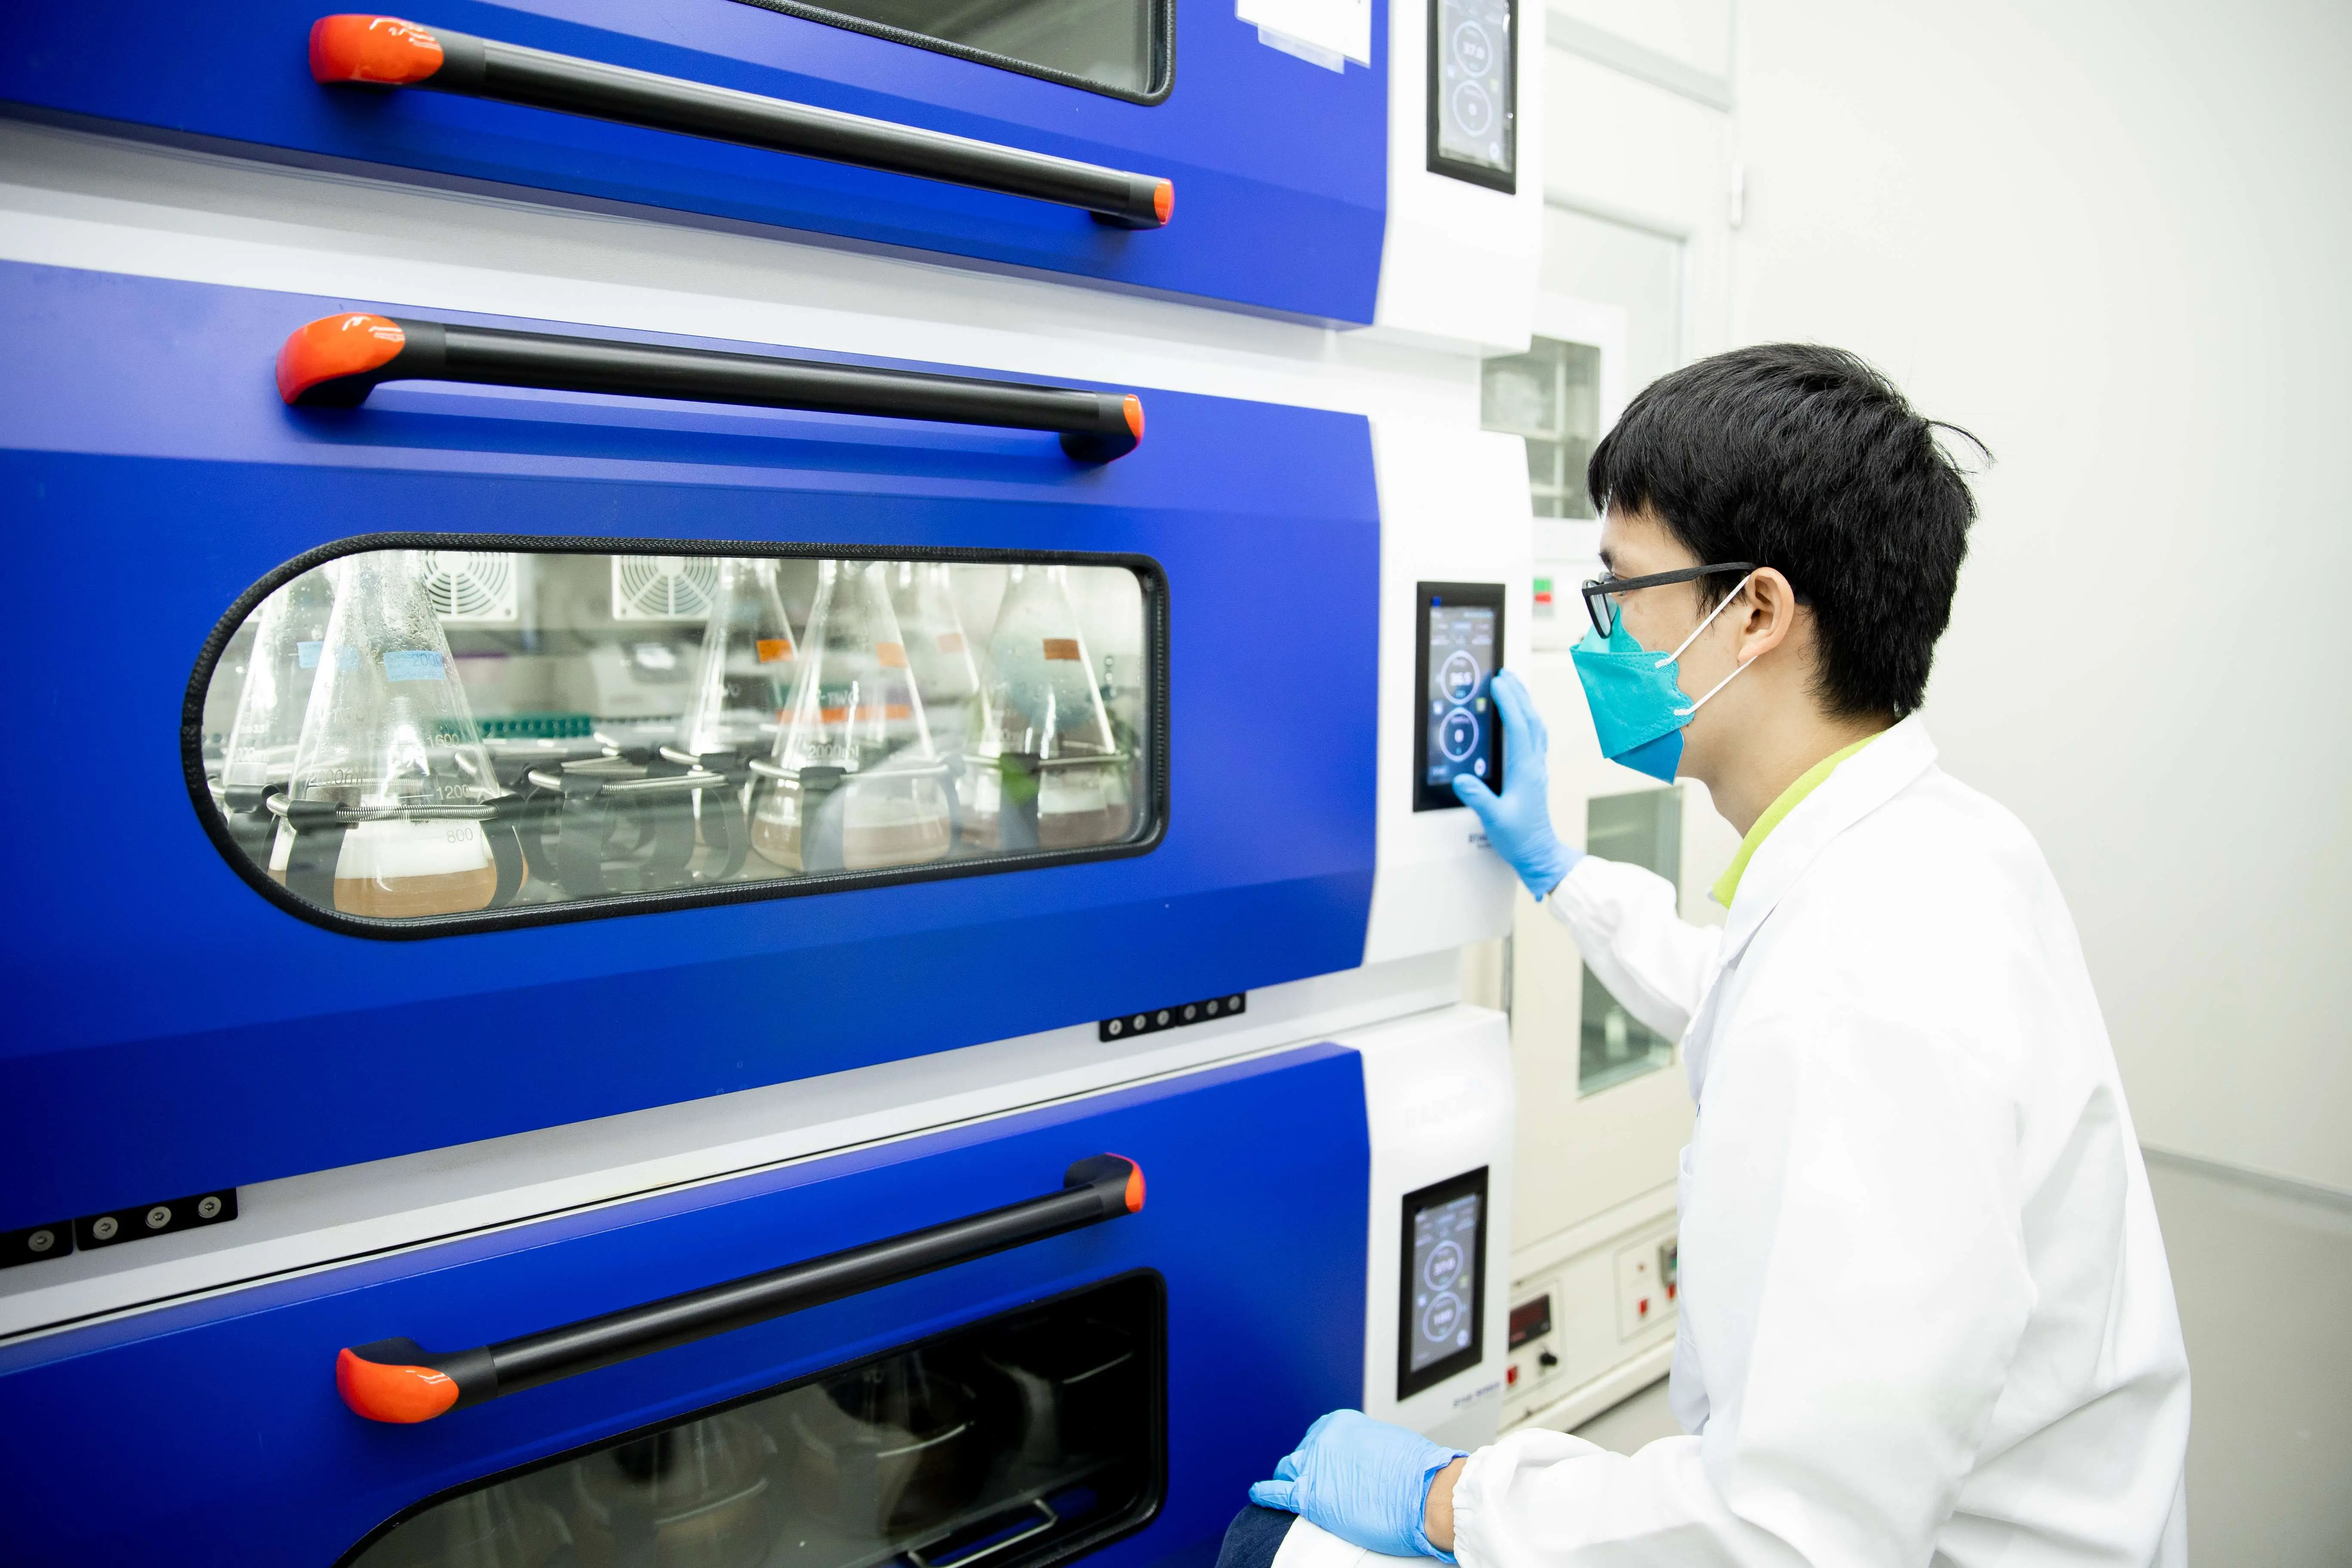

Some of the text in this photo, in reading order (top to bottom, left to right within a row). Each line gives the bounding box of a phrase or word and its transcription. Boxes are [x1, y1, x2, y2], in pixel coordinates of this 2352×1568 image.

[413, 653, 443, 667] 2000
[427, 733, 460, 748] 1600
[308, 766, 364, 786] 2000ml
[436, 784, 471, 800] 1200
[447, 827, 473, 843] 800
